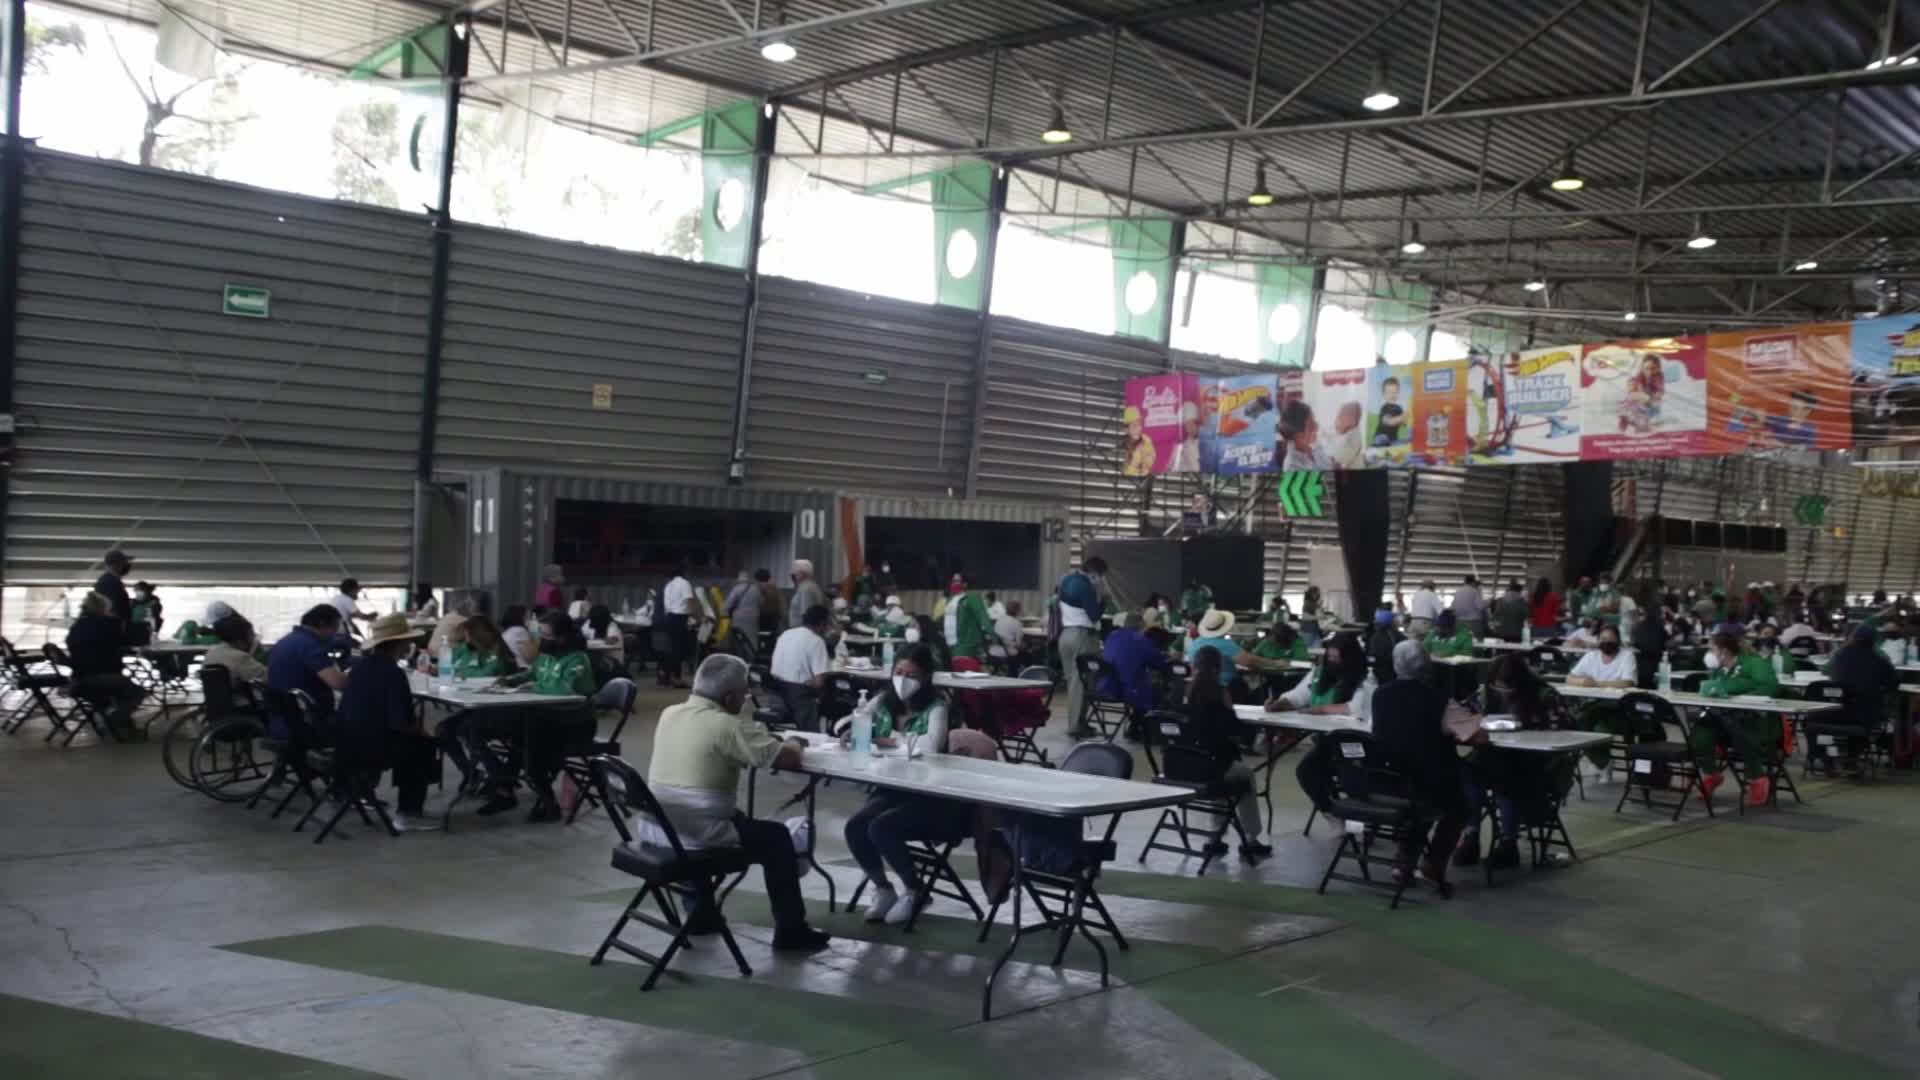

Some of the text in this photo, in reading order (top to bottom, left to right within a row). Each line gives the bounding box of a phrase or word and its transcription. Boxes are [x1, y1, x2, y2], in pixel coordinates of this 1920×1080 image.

[1516, 375, 1566, 389] TRACK
[1506, 388, 1570, 403] BUILDER
[801, 509, 825, 539] 01
[1041, 518, 1064, 543] 02
